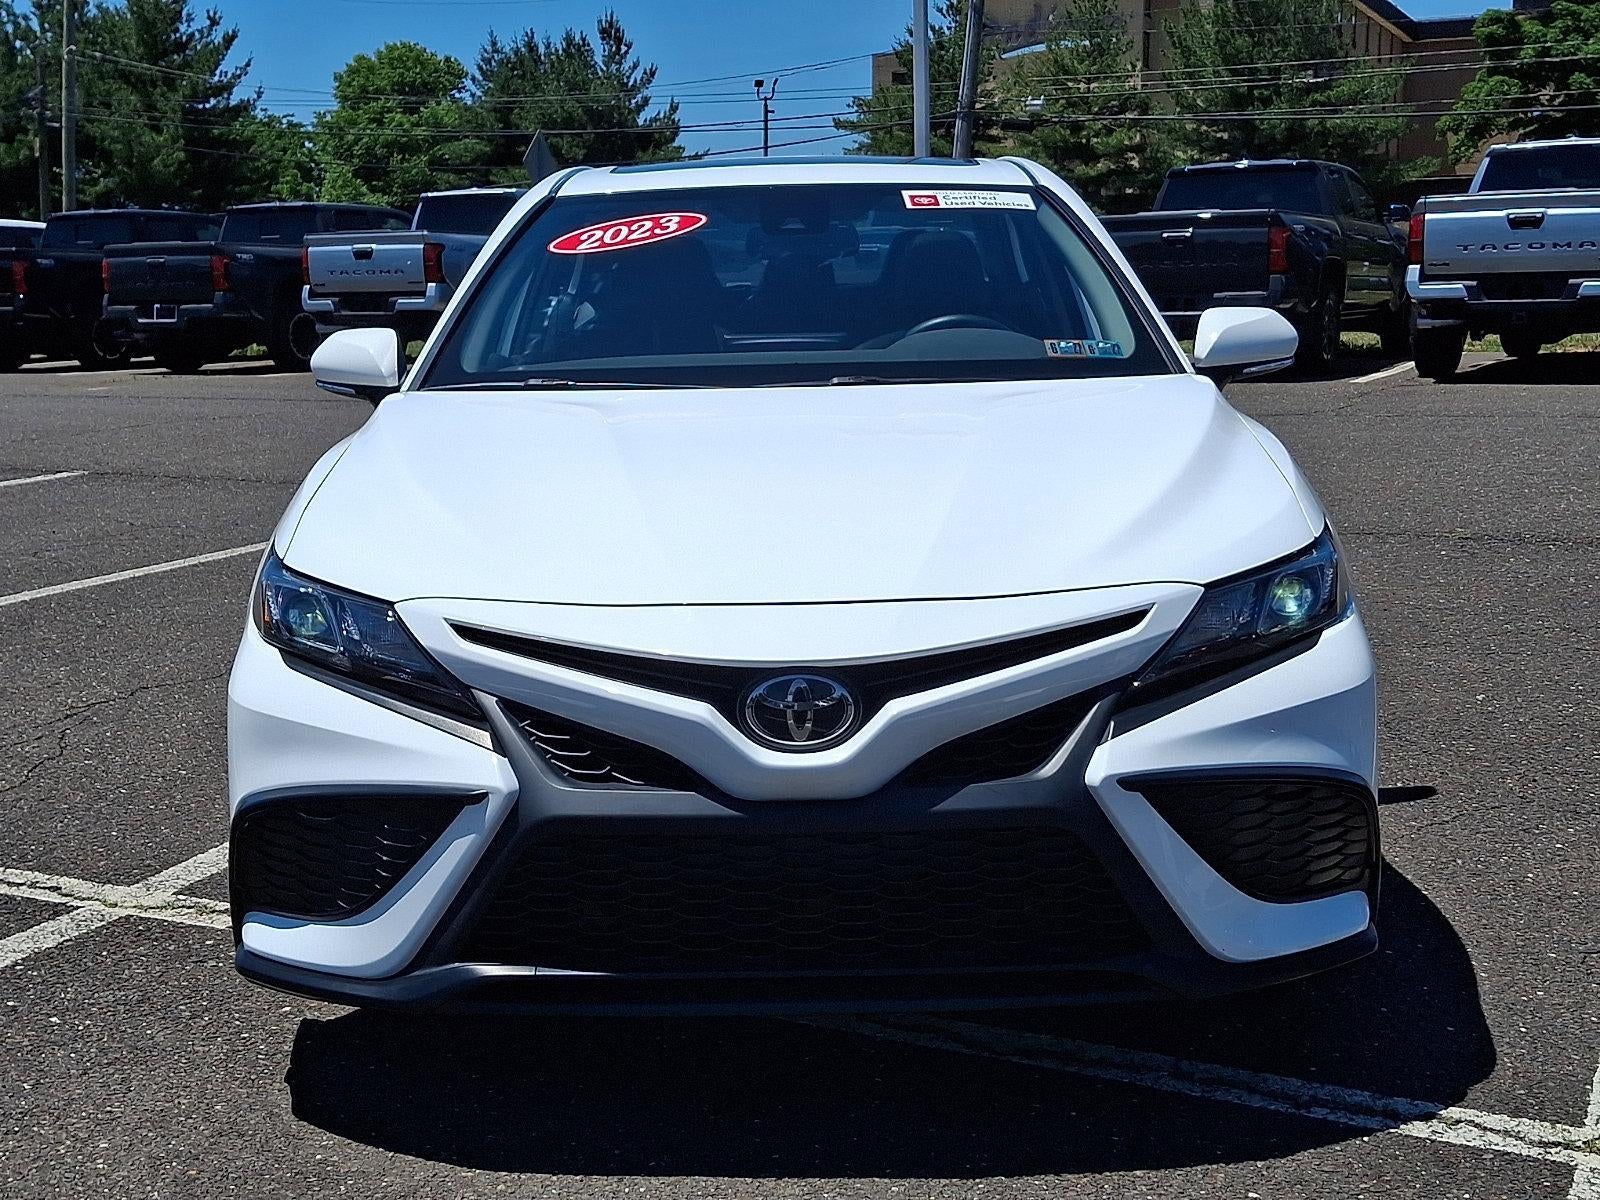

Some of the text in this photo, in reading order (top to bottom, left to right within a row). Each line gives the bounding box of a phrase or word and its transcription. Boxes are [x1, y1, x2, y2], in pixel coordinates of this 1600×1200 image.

[977, 200, 1030, 208] Vehicles
[576, 216, 681, 250] 2023
[1456, 241, 1598, 253] TACOMA
[327, 268, 405, 276] TACOMA
[1050, 342, 1059, 354] 6
[1088, 344, 1096, 355] 6
